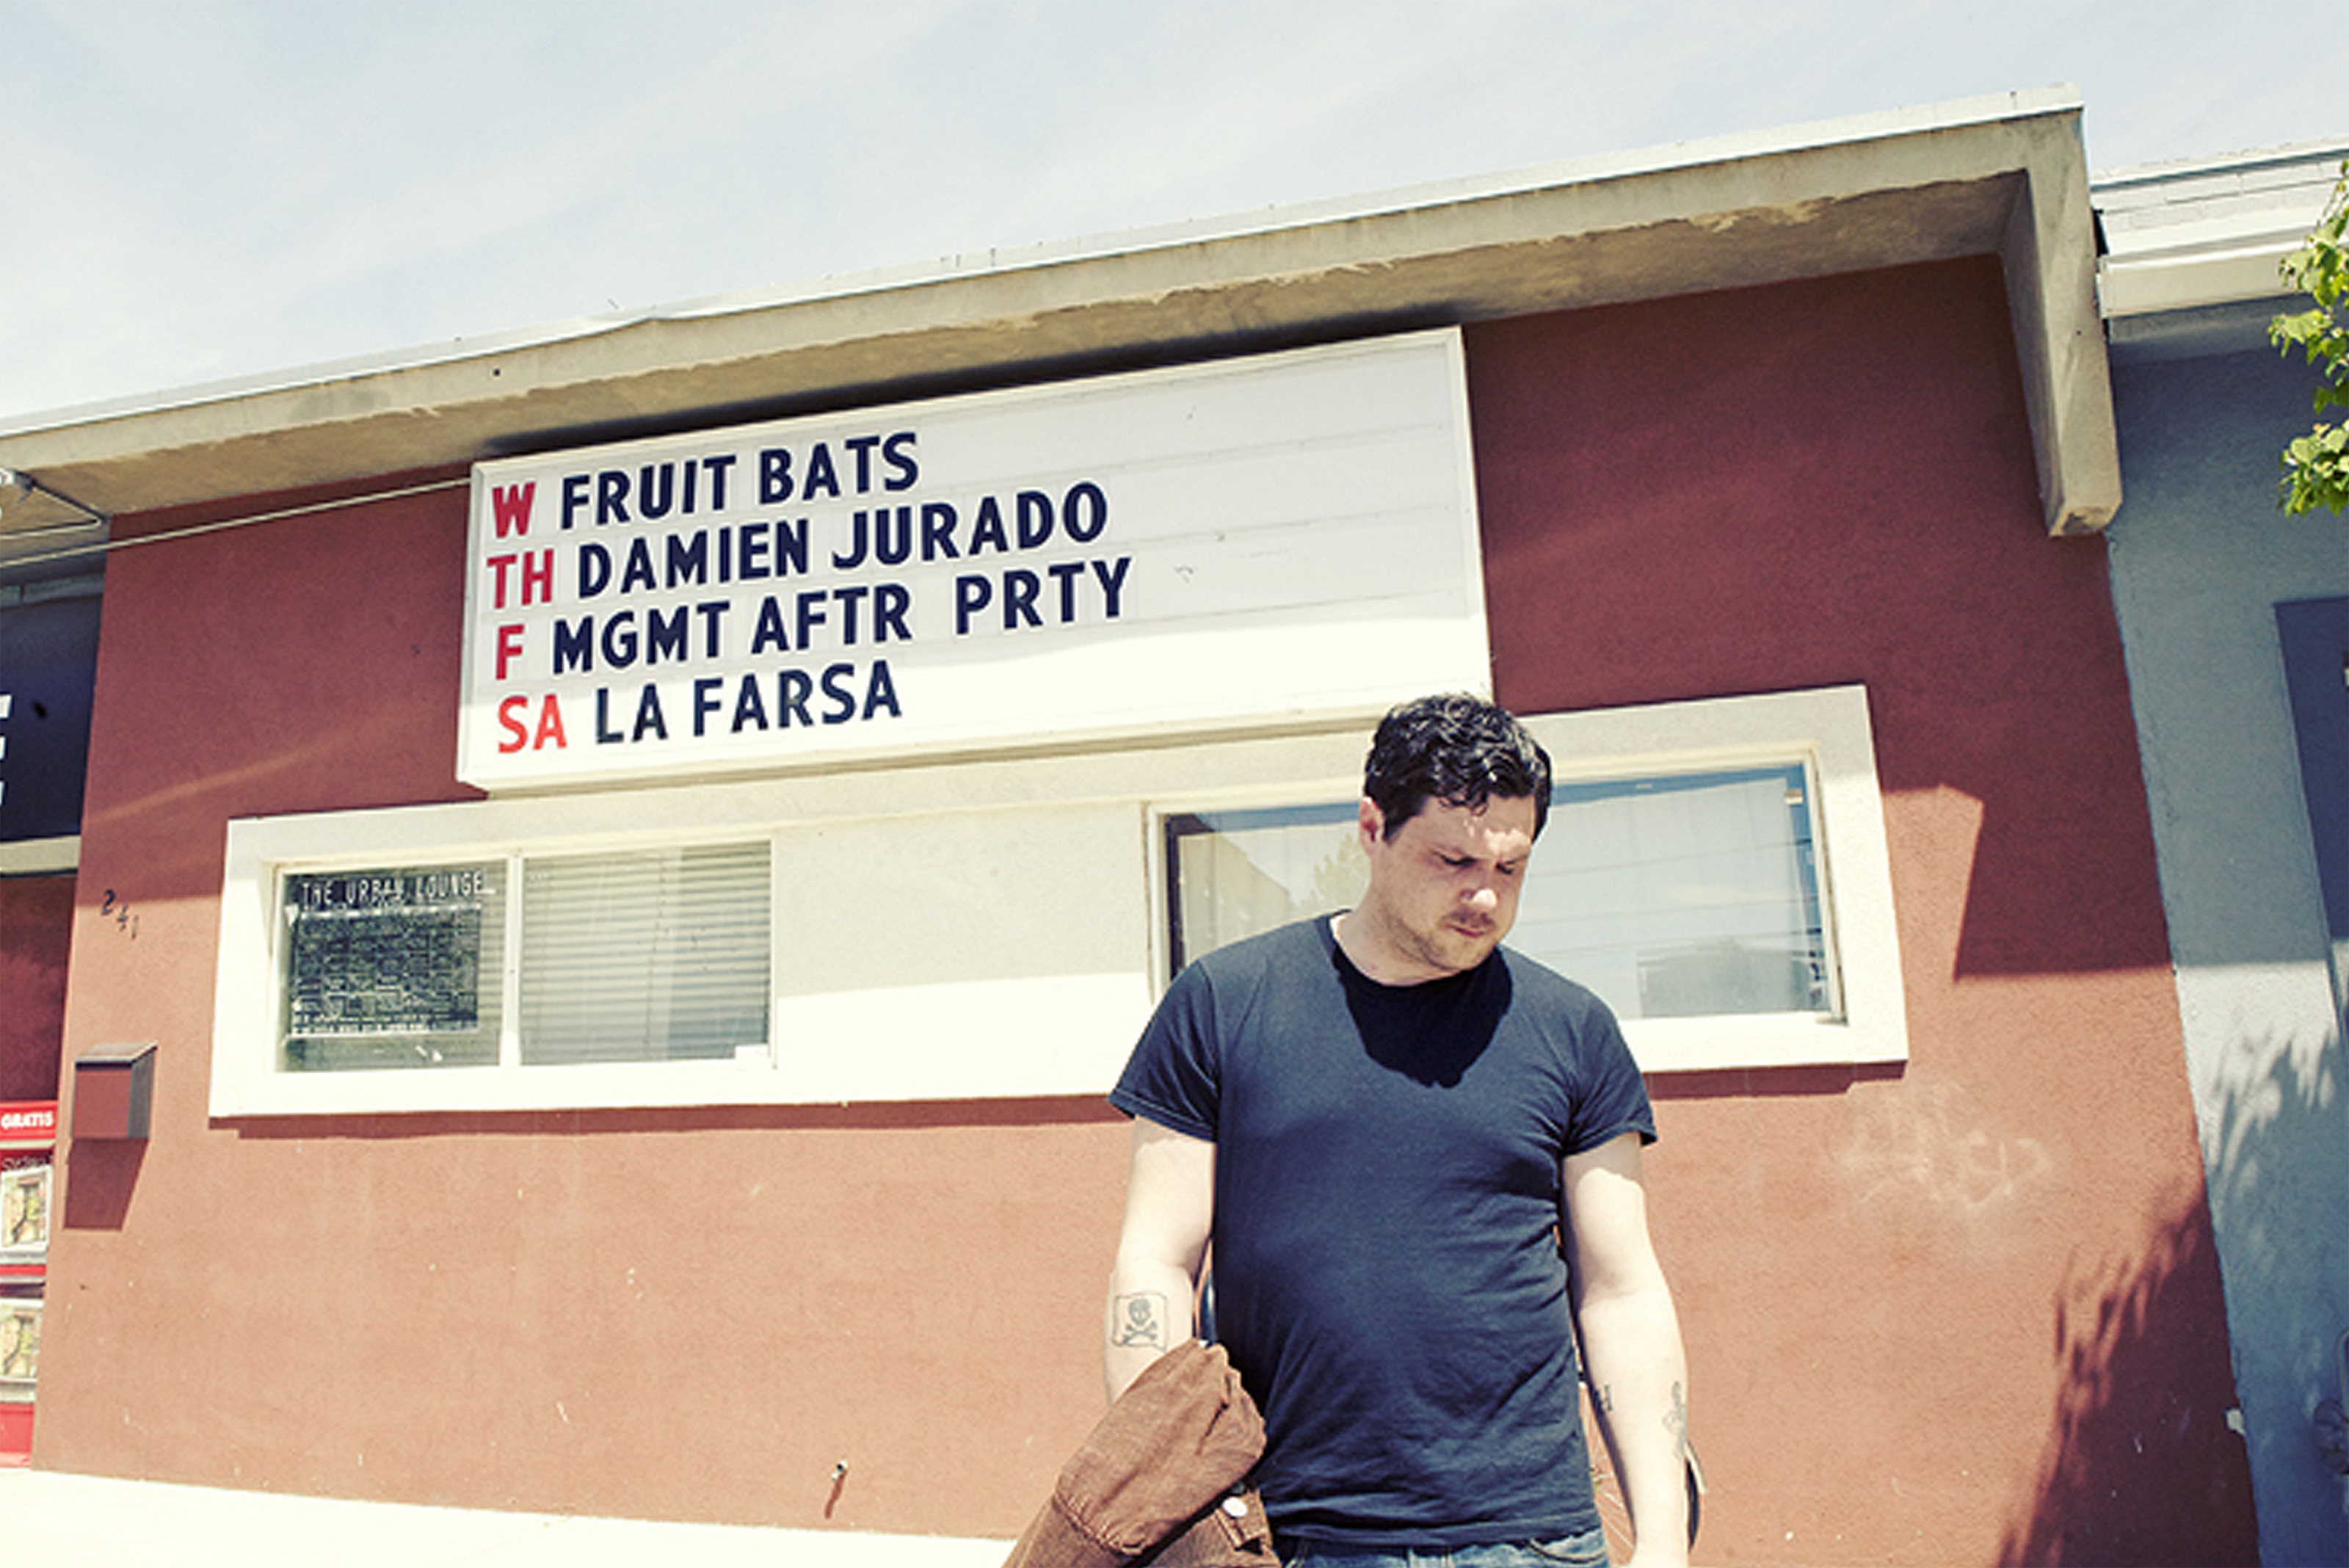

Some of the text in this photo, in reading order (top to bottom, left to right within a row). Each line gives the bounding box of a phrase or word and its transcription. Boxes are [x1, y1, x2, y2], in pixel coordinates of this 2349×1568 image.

[493, 432, 918, 538] W FRUIT BATS
[487, 482, 1107, 609] TH DAMIEN JURADO
[496, 557, 1131, 680] F MGMT AFTR PRTY
[499, 660, 901, 753] SA LA FARSA
[1, 1111, 53, 1130] GRATIS
